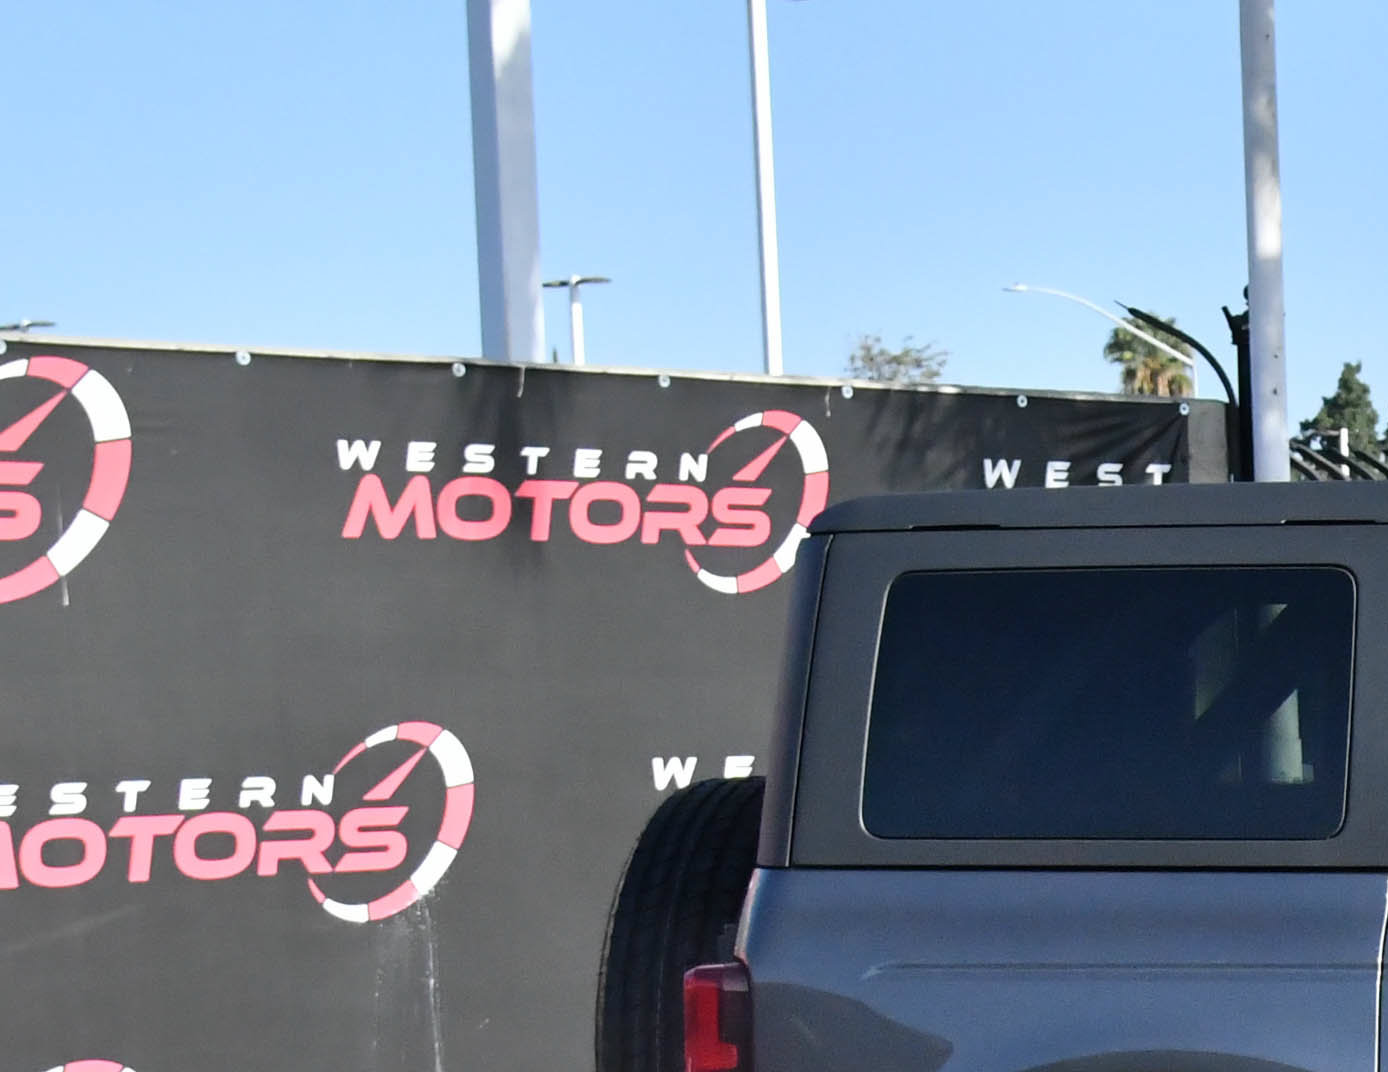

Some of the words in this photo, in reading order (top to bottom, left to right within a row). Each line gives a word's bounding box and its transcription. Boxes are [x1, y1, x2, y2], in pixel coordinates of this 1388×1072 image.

[337, 440, 708, 483] WESTERN
[984, 459, 1171, 488] WEST
[342, 474, 772, 548] MOTORS
[0, 806, 409, 890] OTORS
